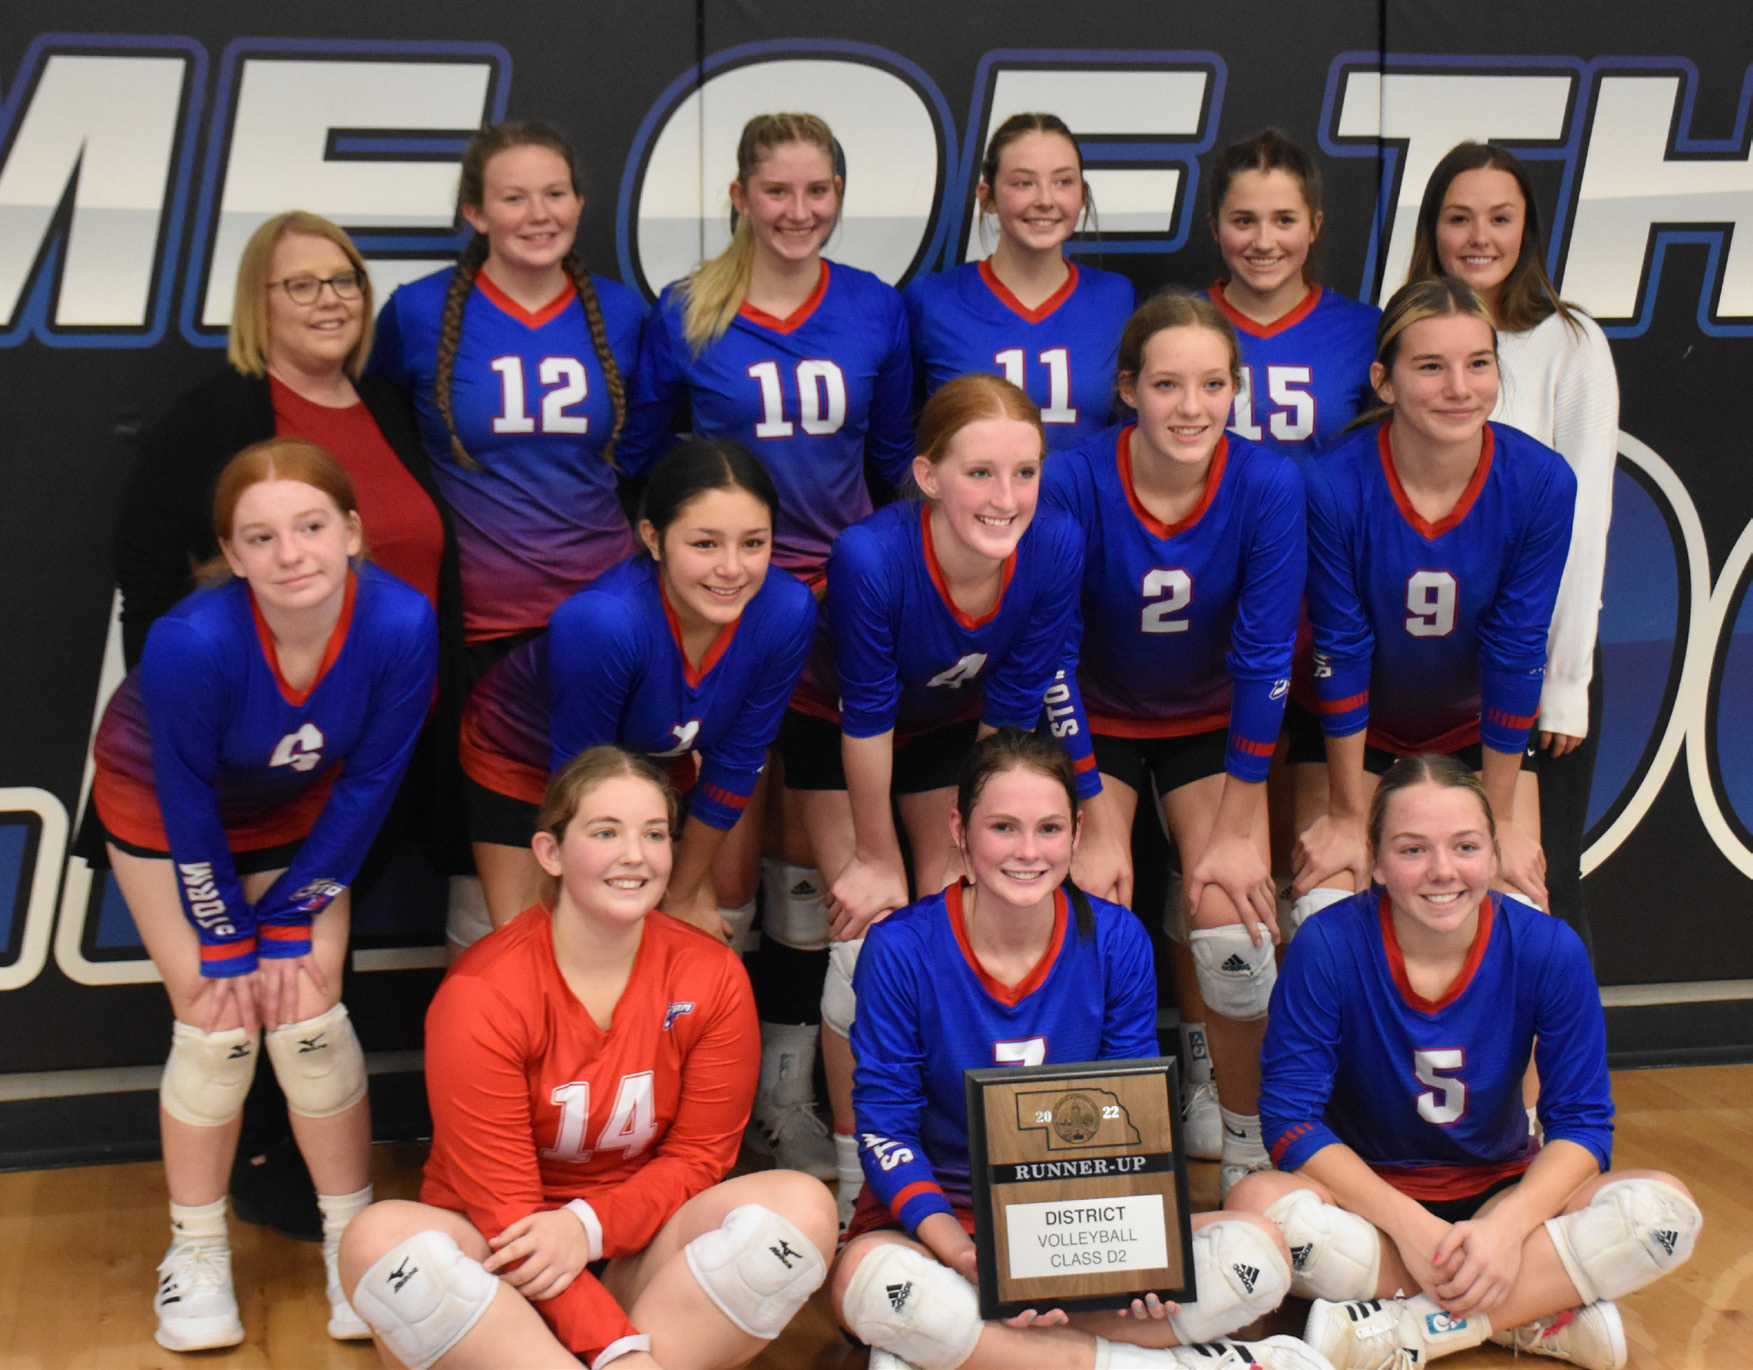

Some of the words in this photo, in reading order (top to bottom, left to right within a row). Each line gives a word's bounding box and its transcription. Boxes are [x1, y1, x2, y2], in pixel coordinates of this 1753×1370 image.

[637, 59, 1208, 300] OF
[489, 355, 589, 435] 12
[747, 358, 847, 439] 10
[994, 347, 1078, 425] 11
[1224, 365, 1317, 442] 15
[1140, 567, 1193, 634] 2
[1404, 568, 1460, 637] 9
[926, 652, 988, 689] 4
[268, 721, 325, 772] 6
[180, 861, 237, 936] STORM
[538, 1070, 657, 1163] 14
[1035, 1110, 1053, 1123] 20
[1102, 1105, 1120, 1118] 22
[1413, 1047, 1468, 1125] 5
[1015, 1155, 1147, 1180] RUNNER-UP
[1037, 1228, 1138, 1248] VOLLEYBALL
[1045, 1206, 1126, 1226] DISTRICT
[1050, 1250, 1102, 1268] CLASS
[1107, 1249, 1127, 1264] D2
